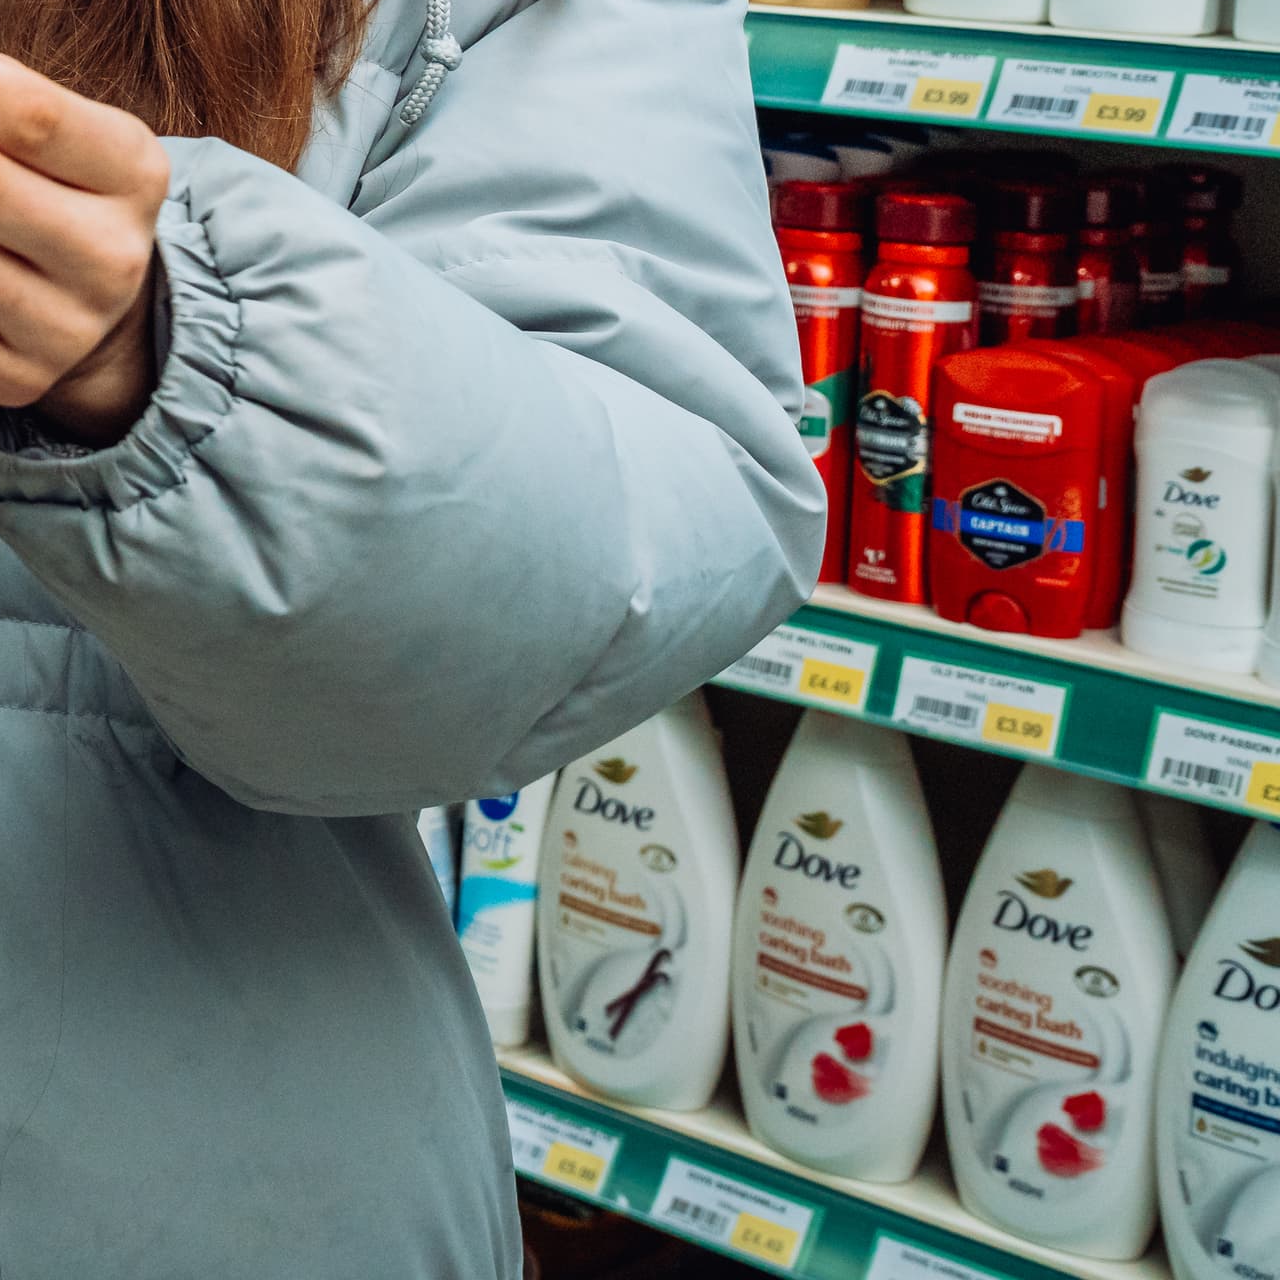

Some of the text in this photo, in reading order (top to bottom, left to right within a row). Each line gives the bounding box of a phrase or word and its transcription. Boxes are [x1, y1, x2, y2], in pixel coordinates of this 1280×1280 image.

[923, 88, 970, 106] £3.99
[1096, 104, 1147, 122] £3.99
[999, 497, 1031, 515] Spice
[1163, 481, 1220, 509] Dove
[970, 516, 1030, 537] CAPTAIN
[995, 716, 1044, 738] £3.99
[573, 777, 655, 831] Dove
[773, 831, 862, 890] Dove
[760, 909, 826, 948] soothing
[993, 889, 1094, 952] Dove
[758, 931, 853, 974] caring bath
[977, 971, 1053, 1014] soothing
[1213, 959, 1280, 1011] Do
[975, 994, 1084, 1041] caring bath
[1195, 1041, 1280, 1084] indulgin
[1193, 1070, 1261, 1108] caring
